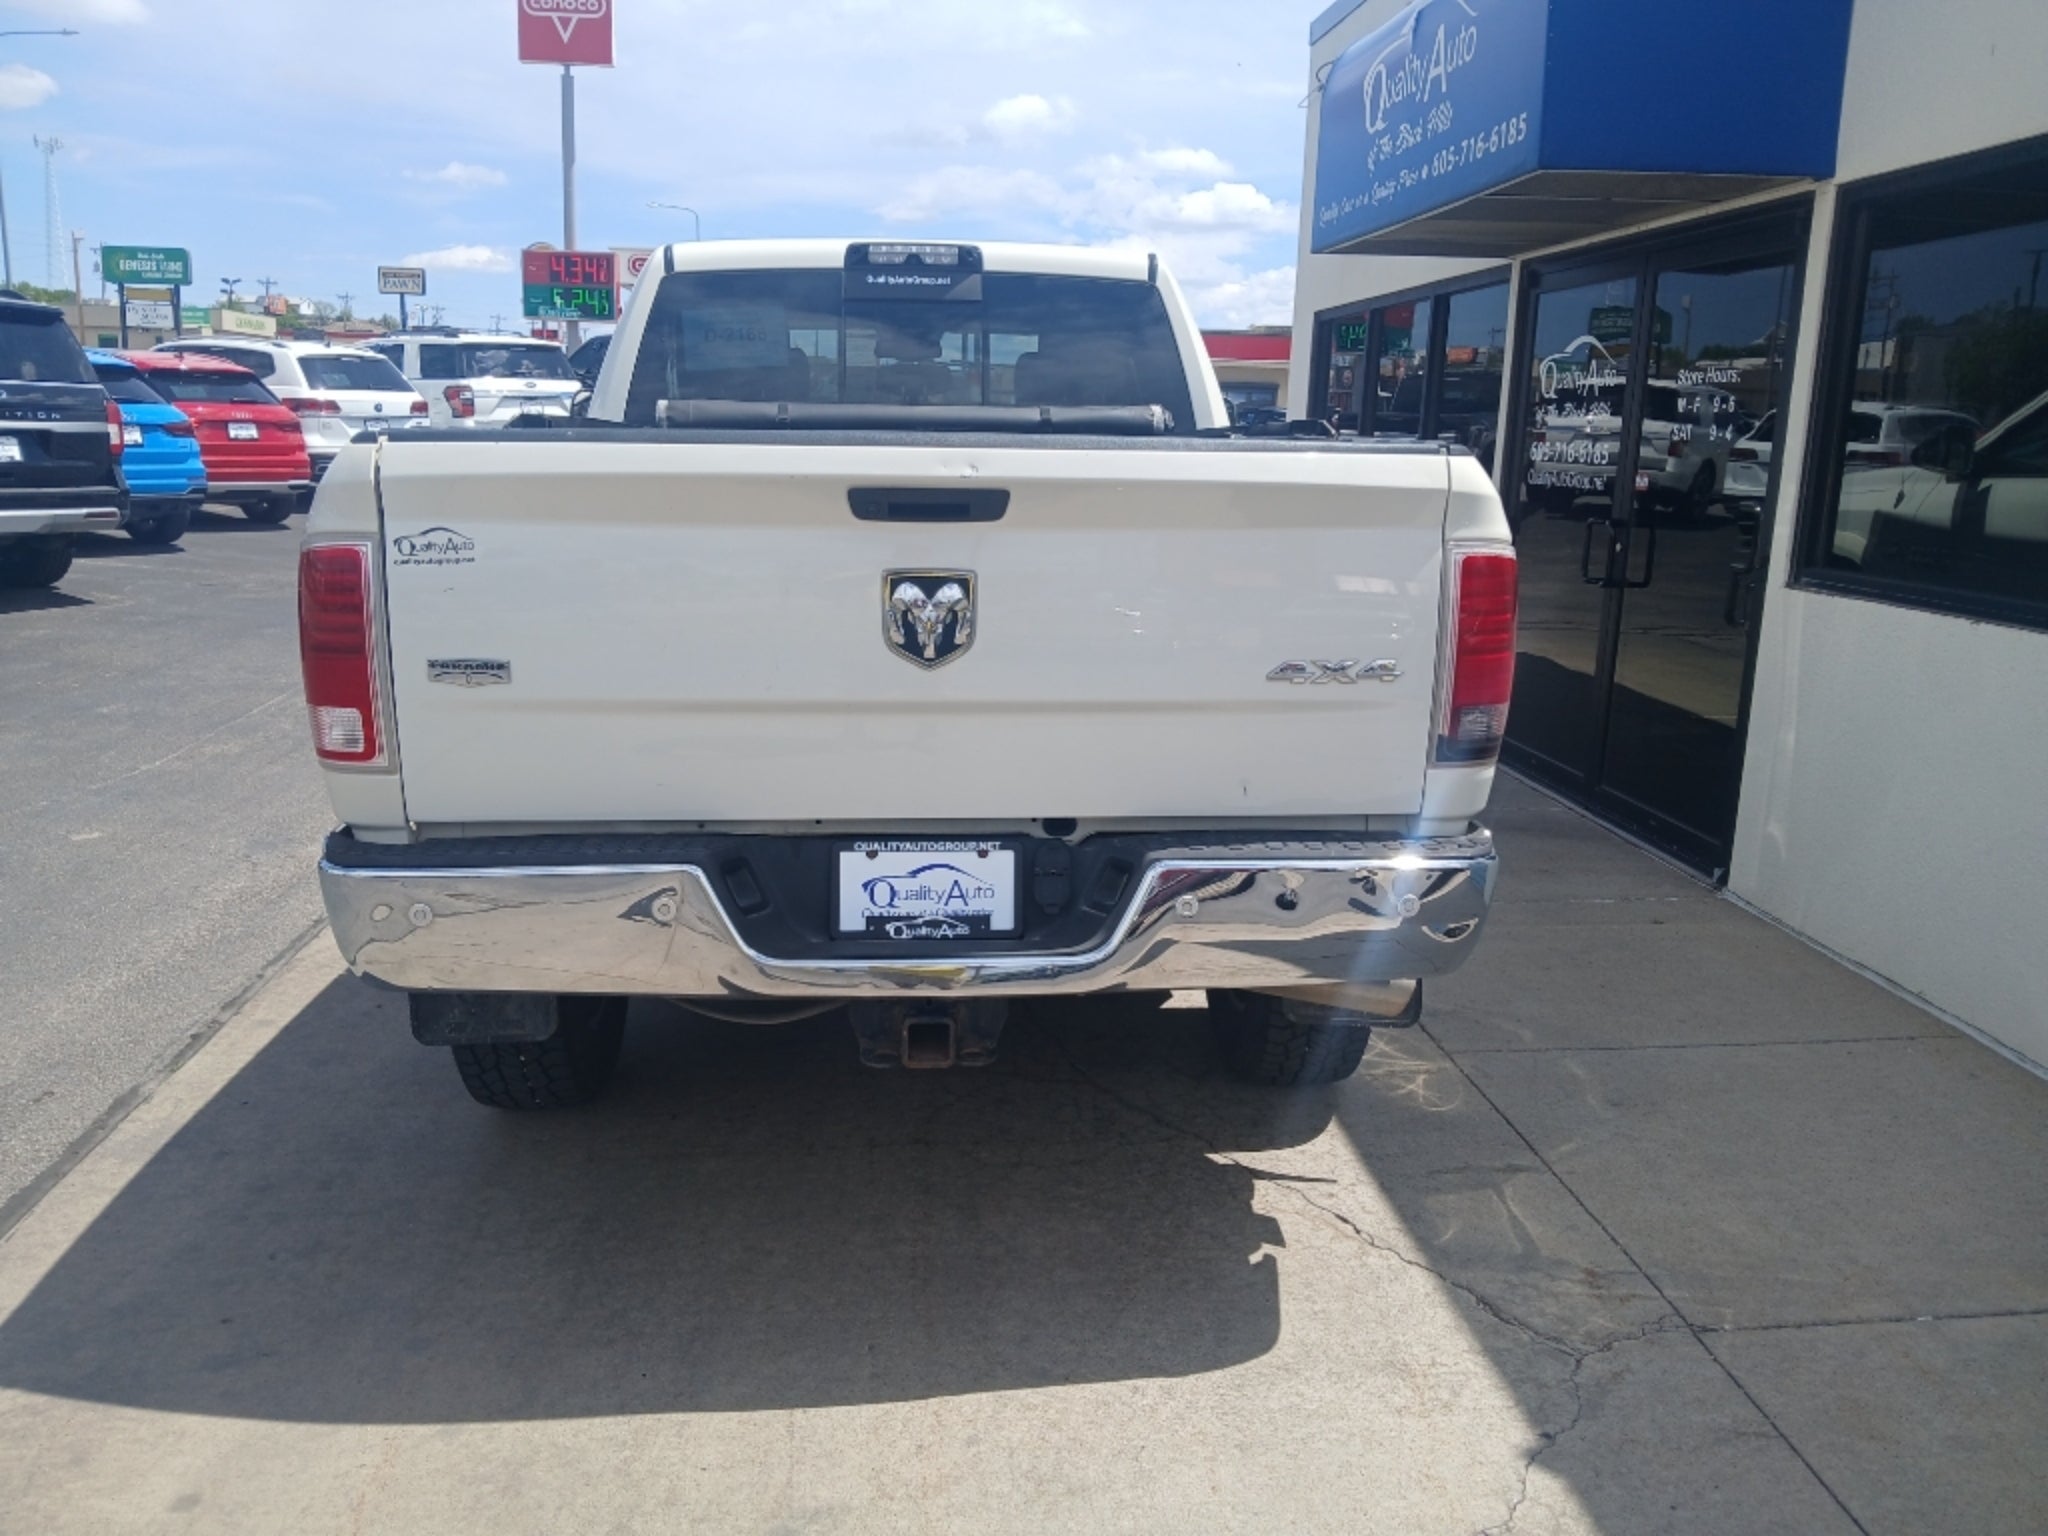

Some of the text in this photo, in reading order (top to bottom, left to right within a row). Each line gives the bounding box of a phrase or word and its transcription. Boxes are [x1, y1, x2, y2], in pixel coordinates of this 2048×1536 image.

[1432, 112, 1528, 177] 605-716-6185
[383, 279, 421, 290] PAWN
[1677, 369, 1704, 385] Store
[1671, 423, 1693, 441] SAT
[1529, 440, 1609, 464] 605-716-6185
[853, 841, 1003, 851] QUALITYAUTOGROUP.NET
